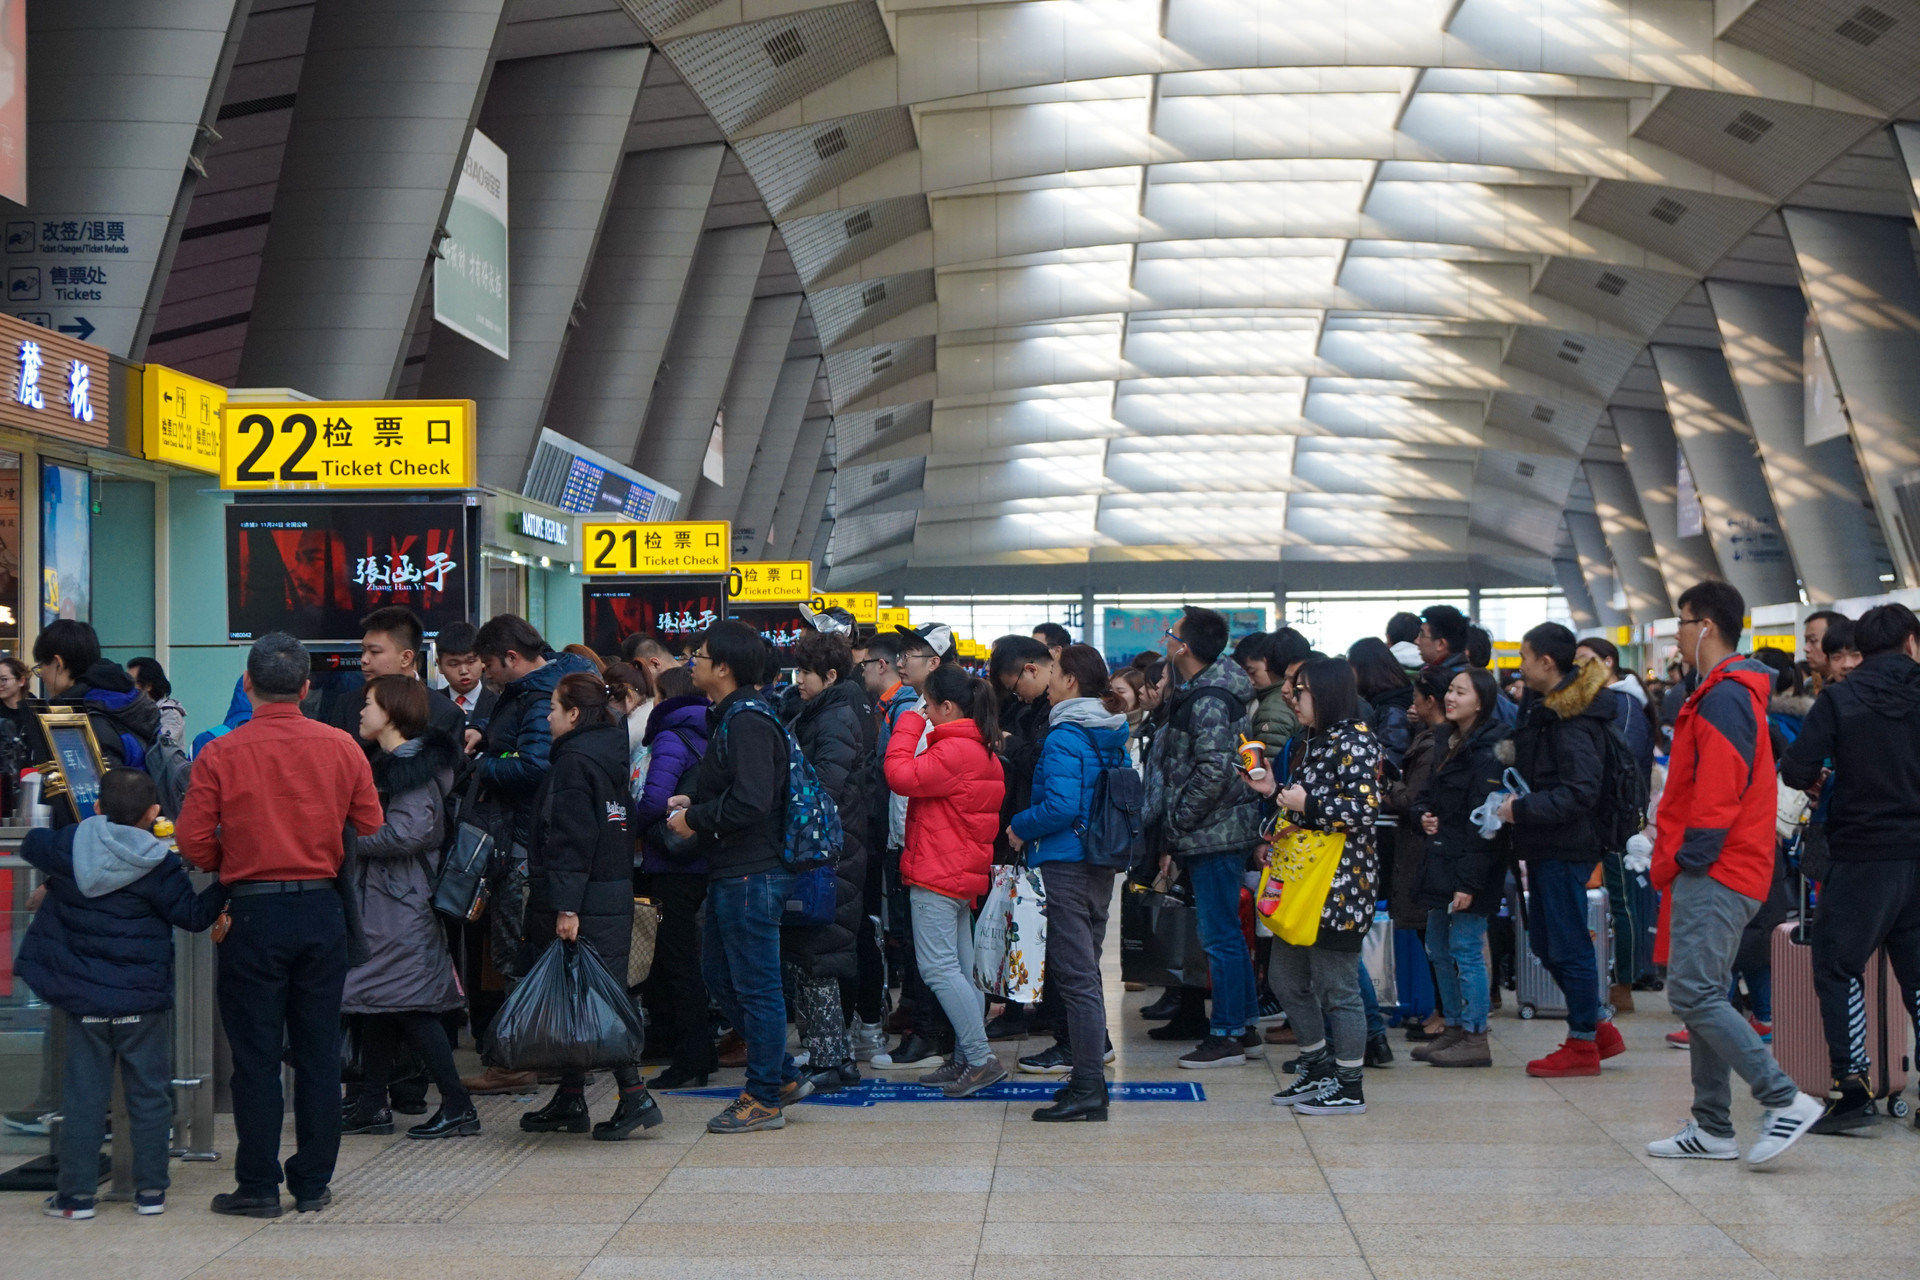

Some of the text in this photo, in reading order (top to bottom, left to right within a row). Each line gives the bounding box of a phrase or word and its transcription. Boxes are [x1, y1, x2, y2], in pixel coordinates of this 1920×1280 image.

[42, 221, 125, 242] 改签/退票
[40, 244, 57, 253] Ticket
[104, 244, 129, 253] Refunds
[50, 266, 107, 285] 售票处
[55, 288, 102, 301] Tickets
[236, 413, 318, 482] 22
[322, 416, 451, 448] 检票口
[321, 459, 450, 476] Ticket Check
[522, 511, 568, 545] NATURE REPUBLIC
[594, 529, 638, 568] 21
[644, 531, 720, 550] 检票口
[643, 555, 719, 566] Ticket Check
[366, 582, 426, 592] Zhang Han Yu
[728, 566, 802, 597] 0 检票口
[744, 586, 802, 595] Ticket Check
[828, 597, 872, 609] 检票口
[882, 612, 904, 622] 票口
